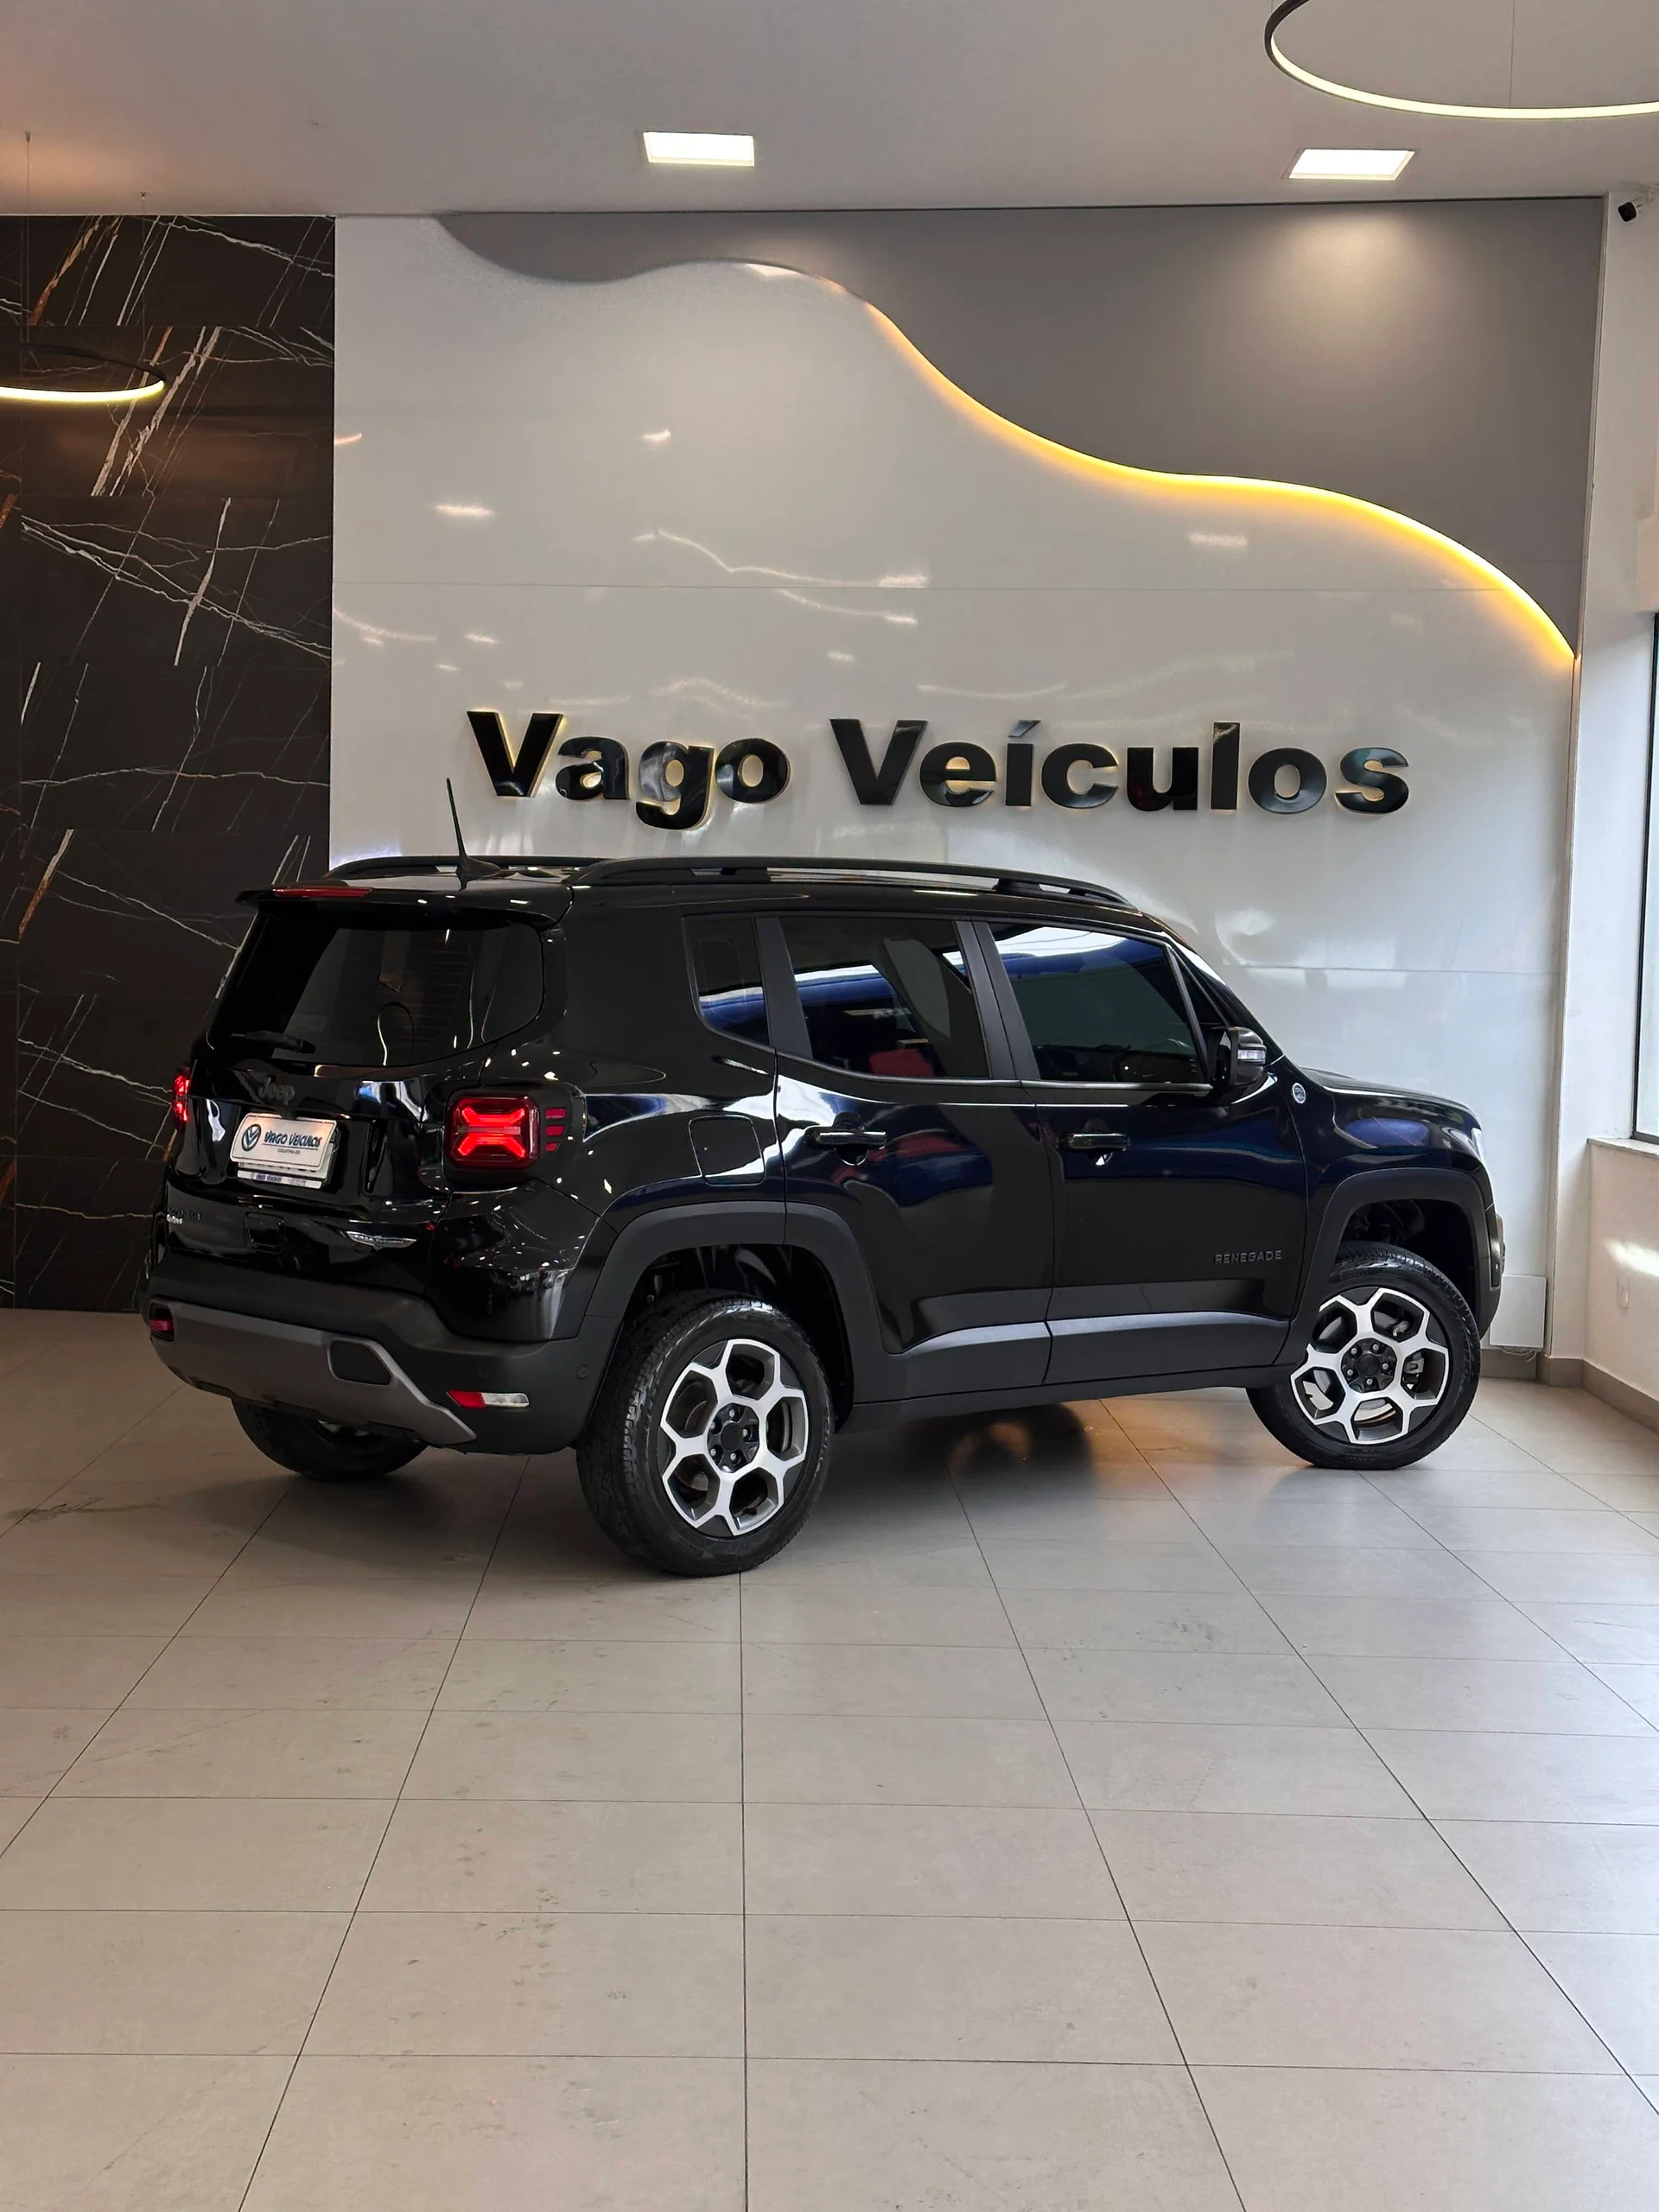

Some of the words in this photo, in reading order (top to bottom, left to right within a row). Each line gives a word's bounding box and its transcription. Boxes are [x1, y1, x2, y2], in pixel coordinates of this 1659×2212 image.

[467, 710, 791, 830] Vago
[830, 718, 1410, 815] Veículos
[258, 1077, 296, 1105] Jeep
[264, 1130, 288, 1145] VAGO
[1214, 1249, 1282, 1265] RENEGADE
